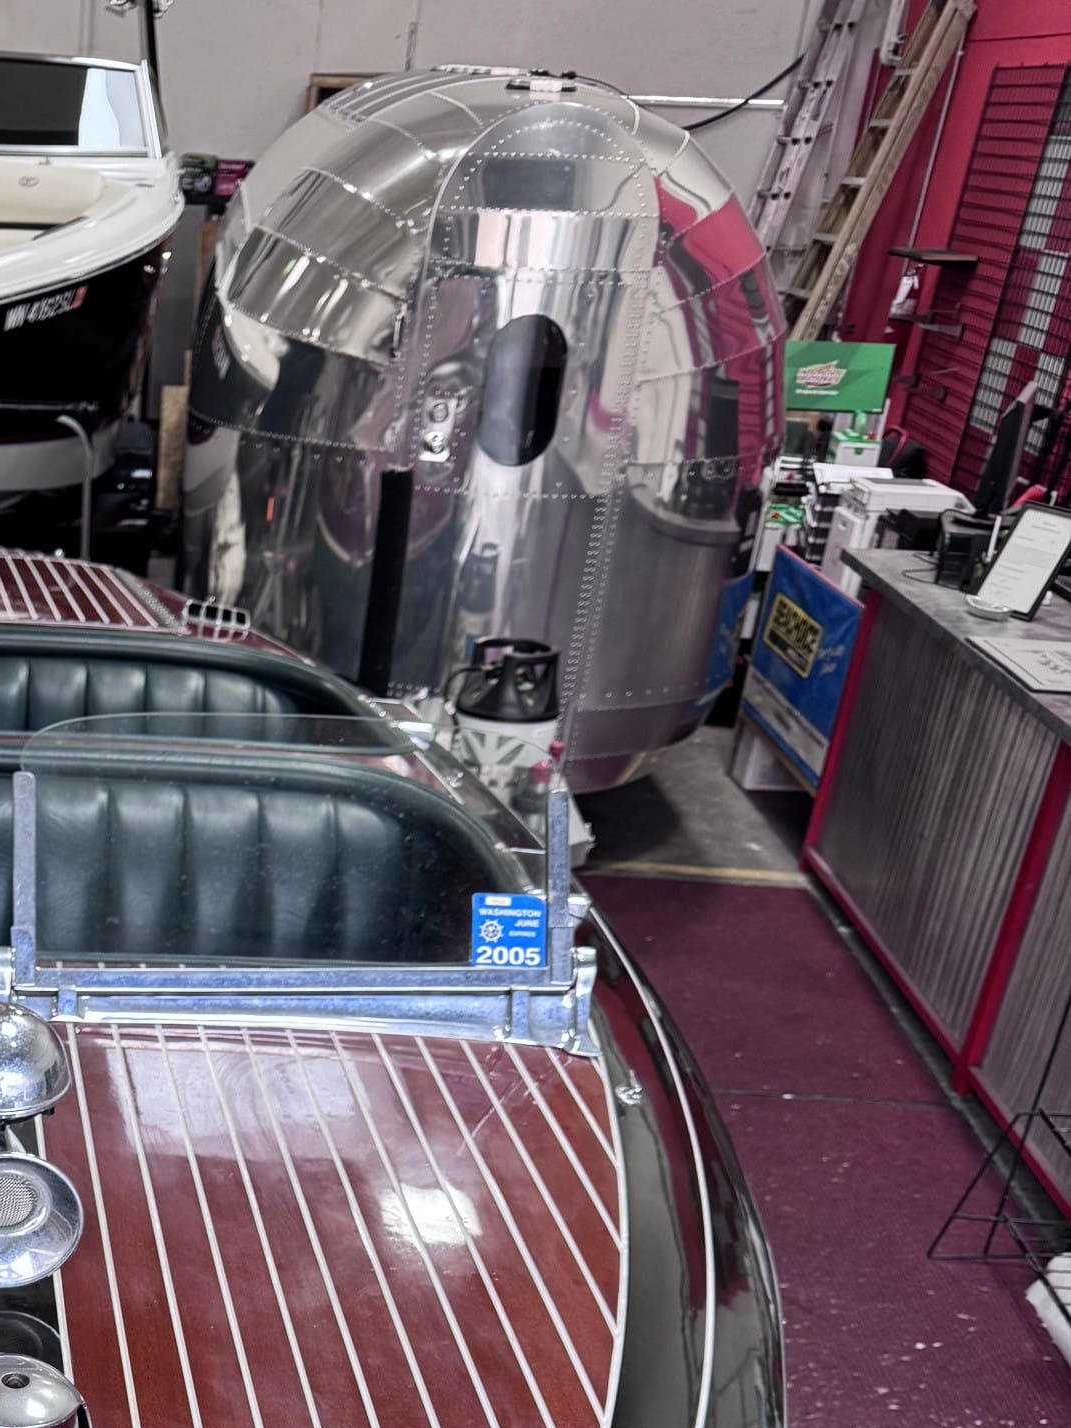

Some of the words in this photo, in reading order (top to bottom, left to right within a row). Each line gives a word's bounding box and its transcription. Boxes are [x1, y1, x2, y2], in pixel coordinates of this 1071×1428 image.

[478, 907, 542, 918] WASHINGTON
[514, 919, 540, 928] JUNE
[476, 945, 542, 966] 2005
